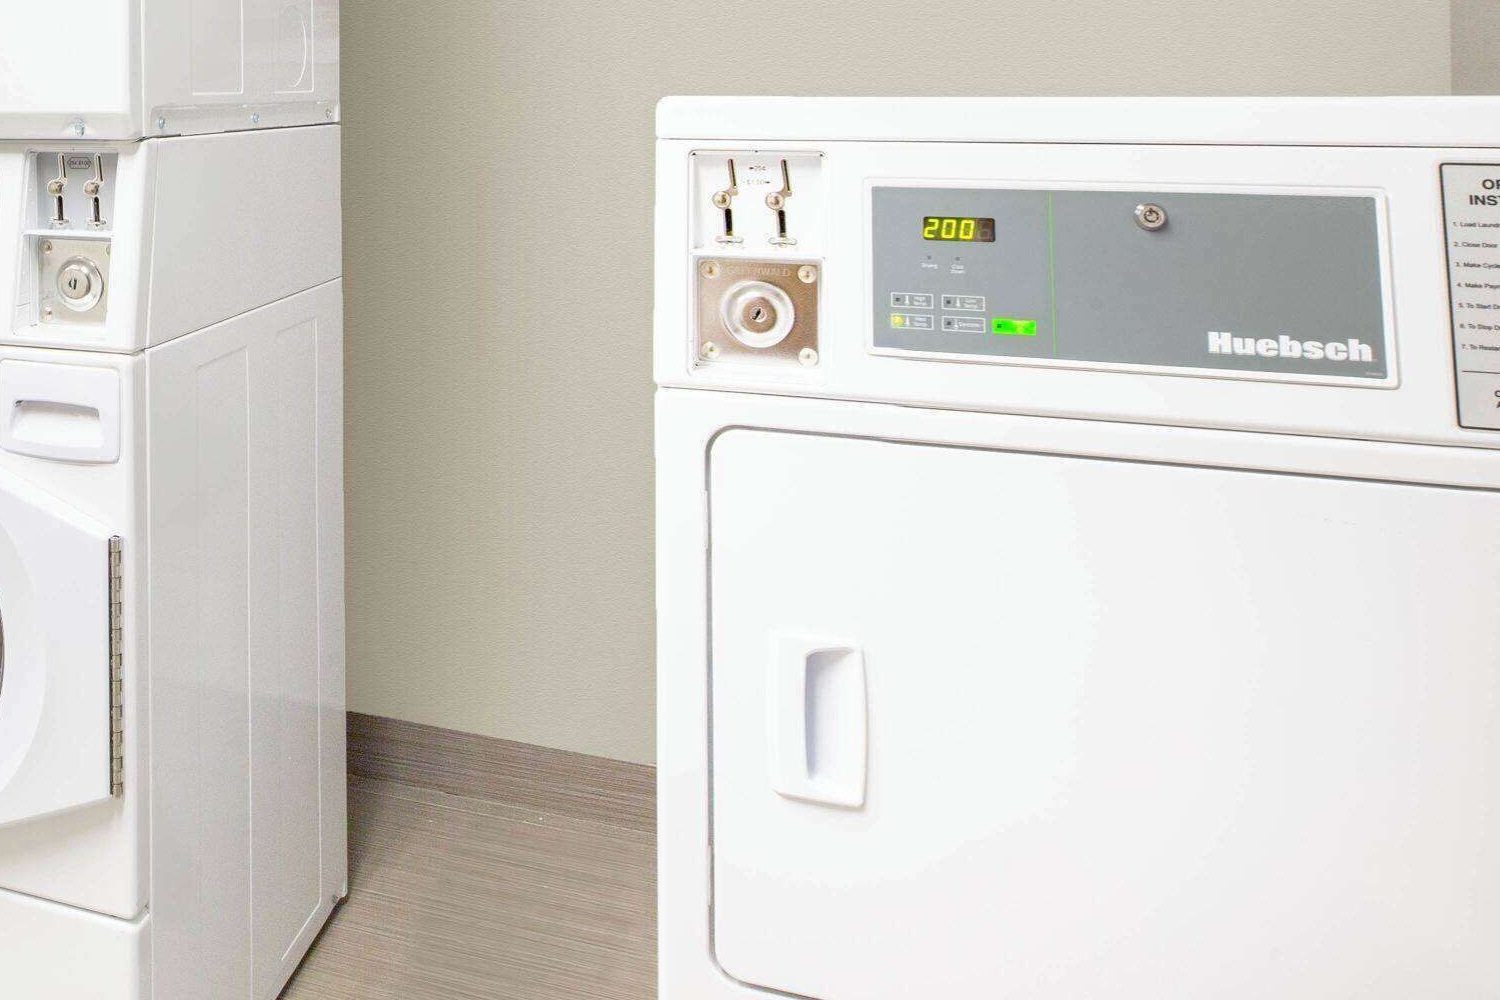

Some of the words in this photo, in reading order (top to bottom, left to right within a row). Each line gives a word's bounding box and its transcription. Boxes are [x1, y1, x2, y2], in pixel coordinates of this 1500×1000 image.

[1469, 195, 1500, 206] INS
[923, 219, 976, 240] 200
[1207, 331, 1373, 362] Huebsch
